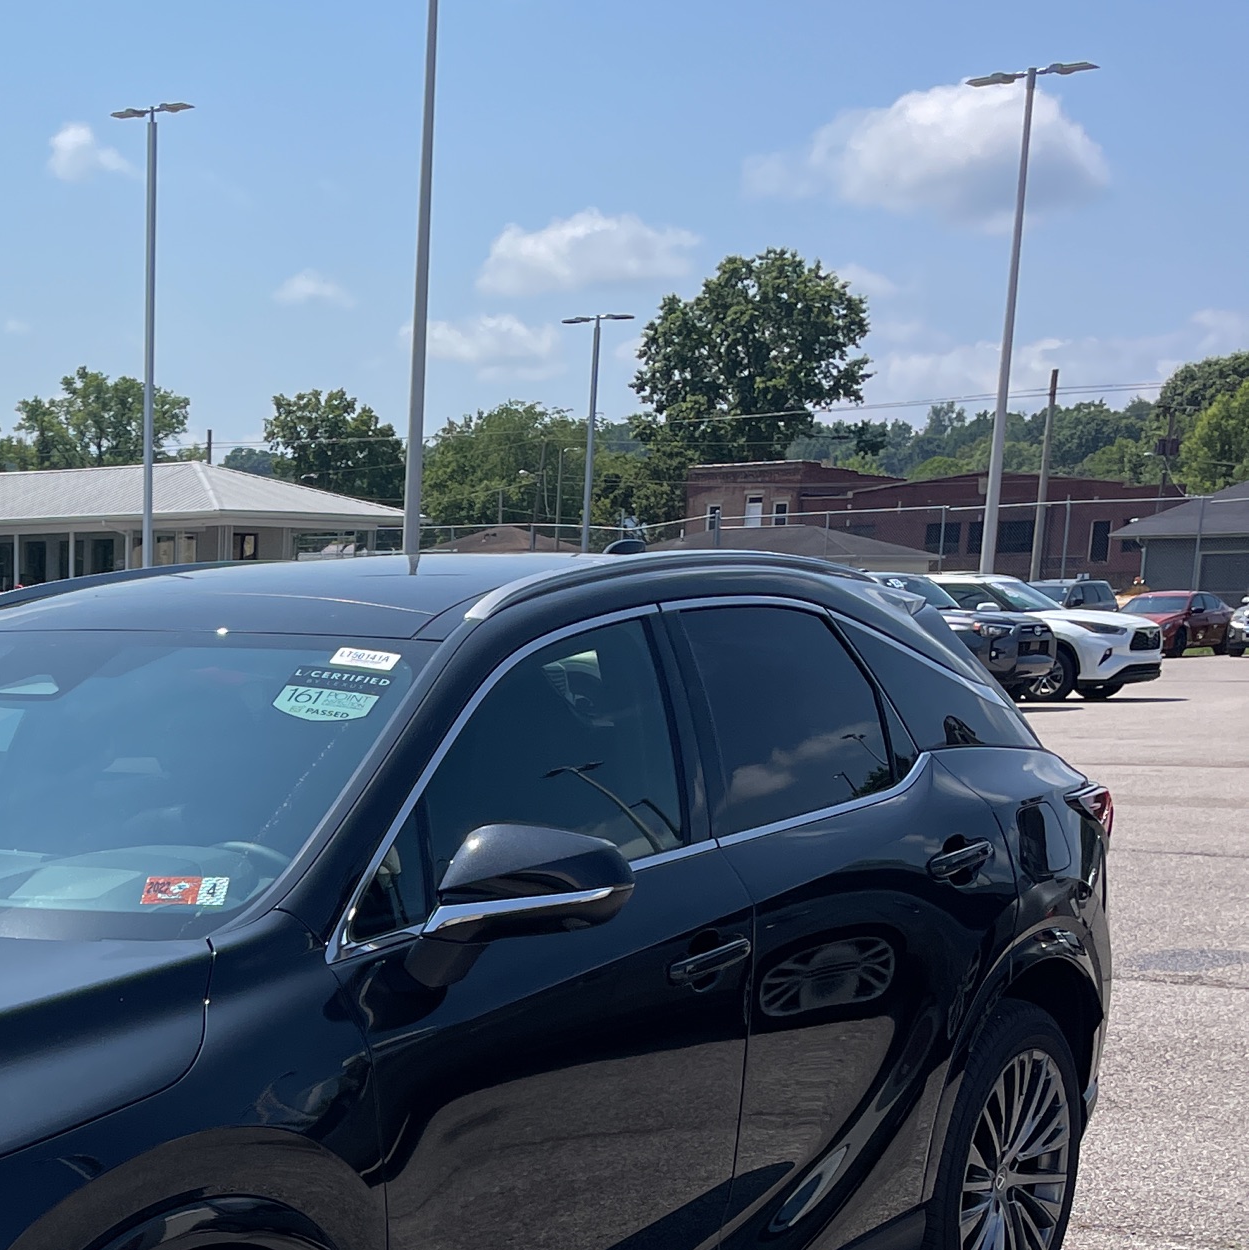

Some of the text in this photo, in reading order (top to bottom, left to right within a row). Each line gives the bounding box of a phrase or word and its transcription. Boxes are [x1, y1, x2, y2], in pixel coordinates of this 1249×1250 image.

[326, 680, 365, 690] LEXUS
[286, 687, 372, 705] 161 POINT
[304, 707, 350, 719] PASSED
[206, 882, 218, 898] 4
